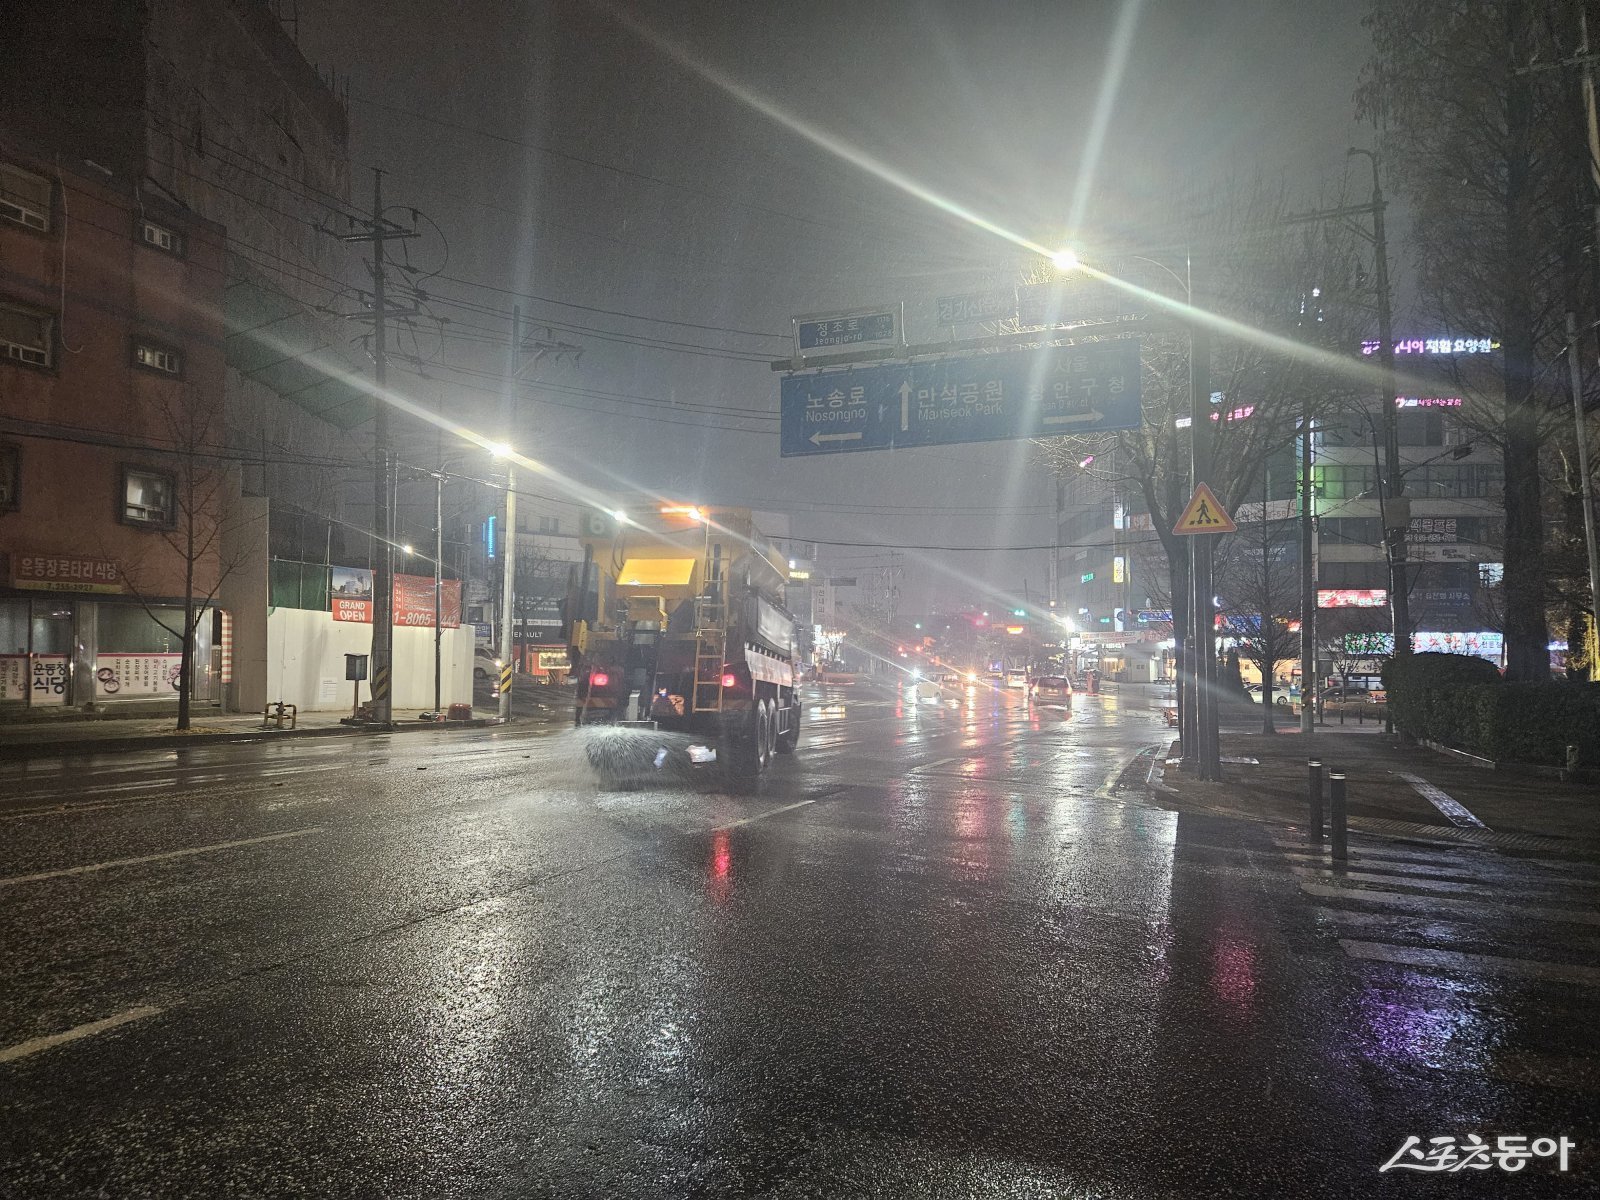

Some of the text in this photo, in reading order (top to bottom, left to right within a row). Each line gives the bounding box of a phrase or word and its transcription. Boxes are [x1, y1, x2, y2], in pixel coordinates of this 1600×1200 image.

[816, 320, 859, 337] 정조로
[806, 386, 868, 409] 노송로
[917, 379, 1004, 408] 만석공원
[805, 408, 867, 423] Nosongno
[21, 557, 117, 580] 운동장로타리 식당
[339, 600, 366, 610] GRAND
[339, 611, 365, 621] OPEN
[33, 677, 68, 694] 식당
